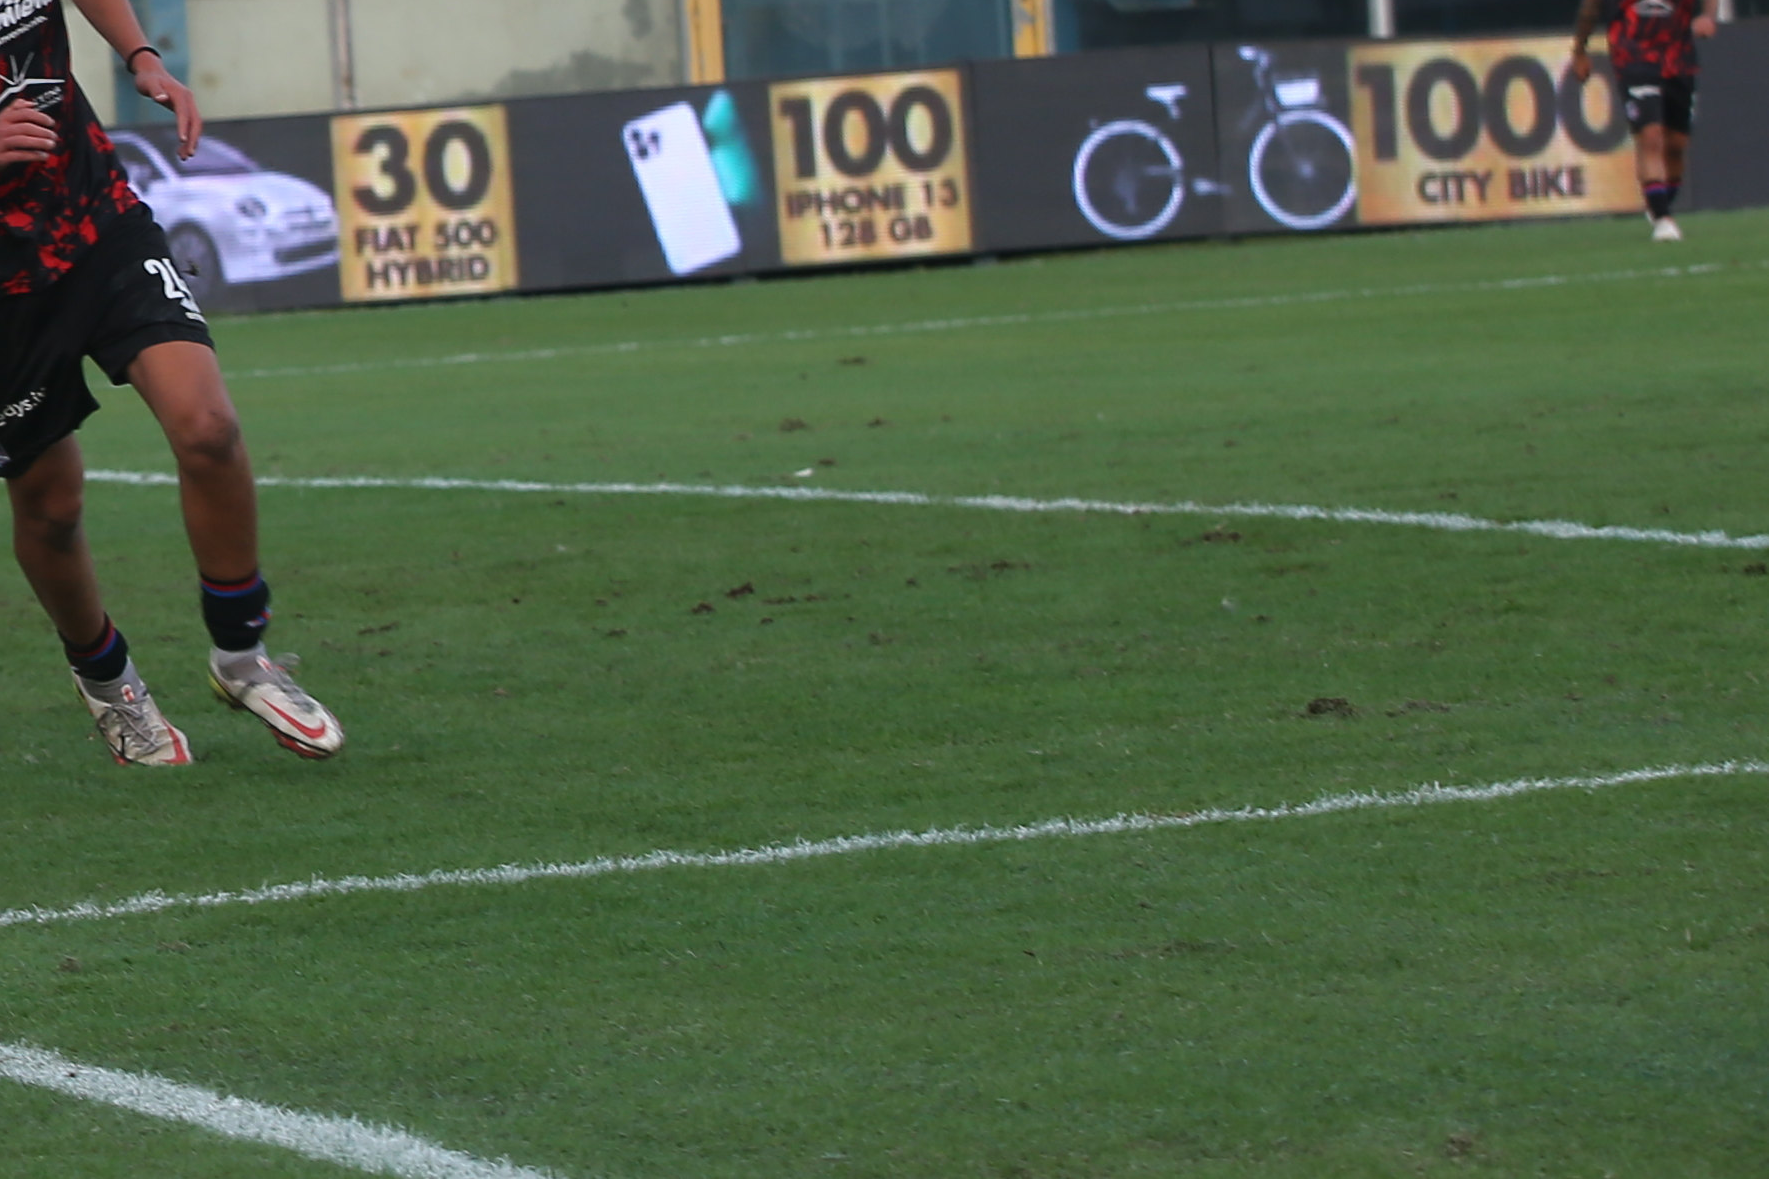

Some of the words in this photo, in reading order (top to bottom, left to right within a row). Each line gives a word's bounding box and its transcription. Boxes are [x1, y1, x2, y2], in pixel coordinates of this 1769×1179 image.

[780, 85, 952, 178] 100
[1354, 51, 1629, 162] 1000
[353, 120, 492, 216] 30
[1418, 168, 1494, 204] CITY
[1509, 165, 1585, 198] BIKE
[356, 224, 419, 254] FIAT
[434, 219, 497, 250] 500
[366, 255, 490, 288] HYBRID
